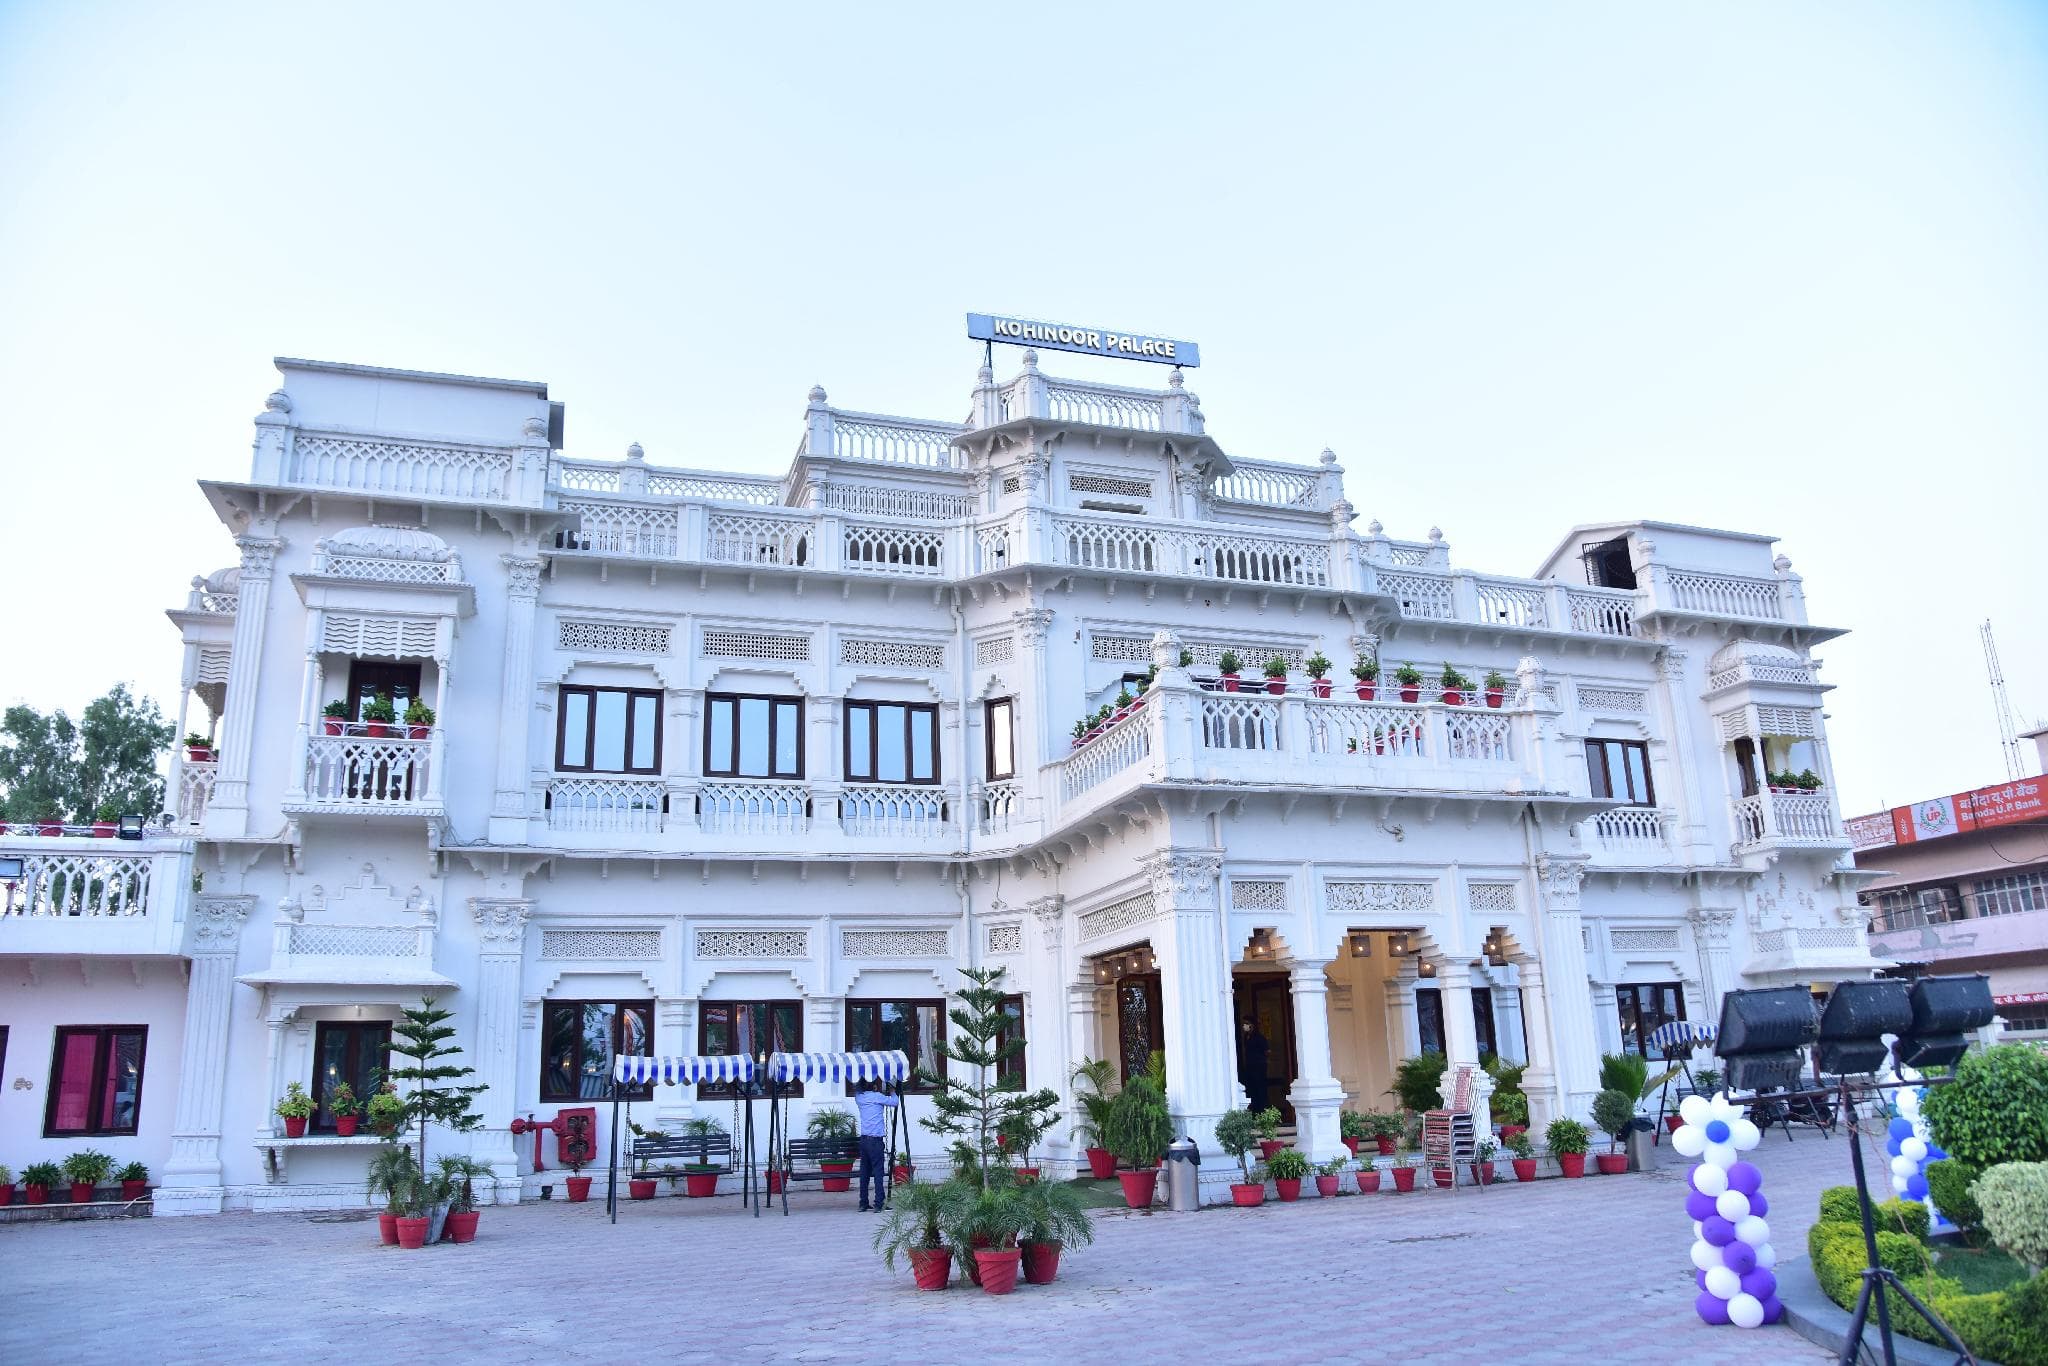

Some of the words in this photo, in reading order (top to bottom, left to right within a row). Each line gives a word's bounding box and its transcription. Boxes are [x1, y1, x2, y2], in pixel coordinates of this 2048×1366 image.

[995, 319, 1101, 348] KOHINOOR
[1105, 335, 1176, 357] PALACE
[2015, 797, 2041, 810] Bank
